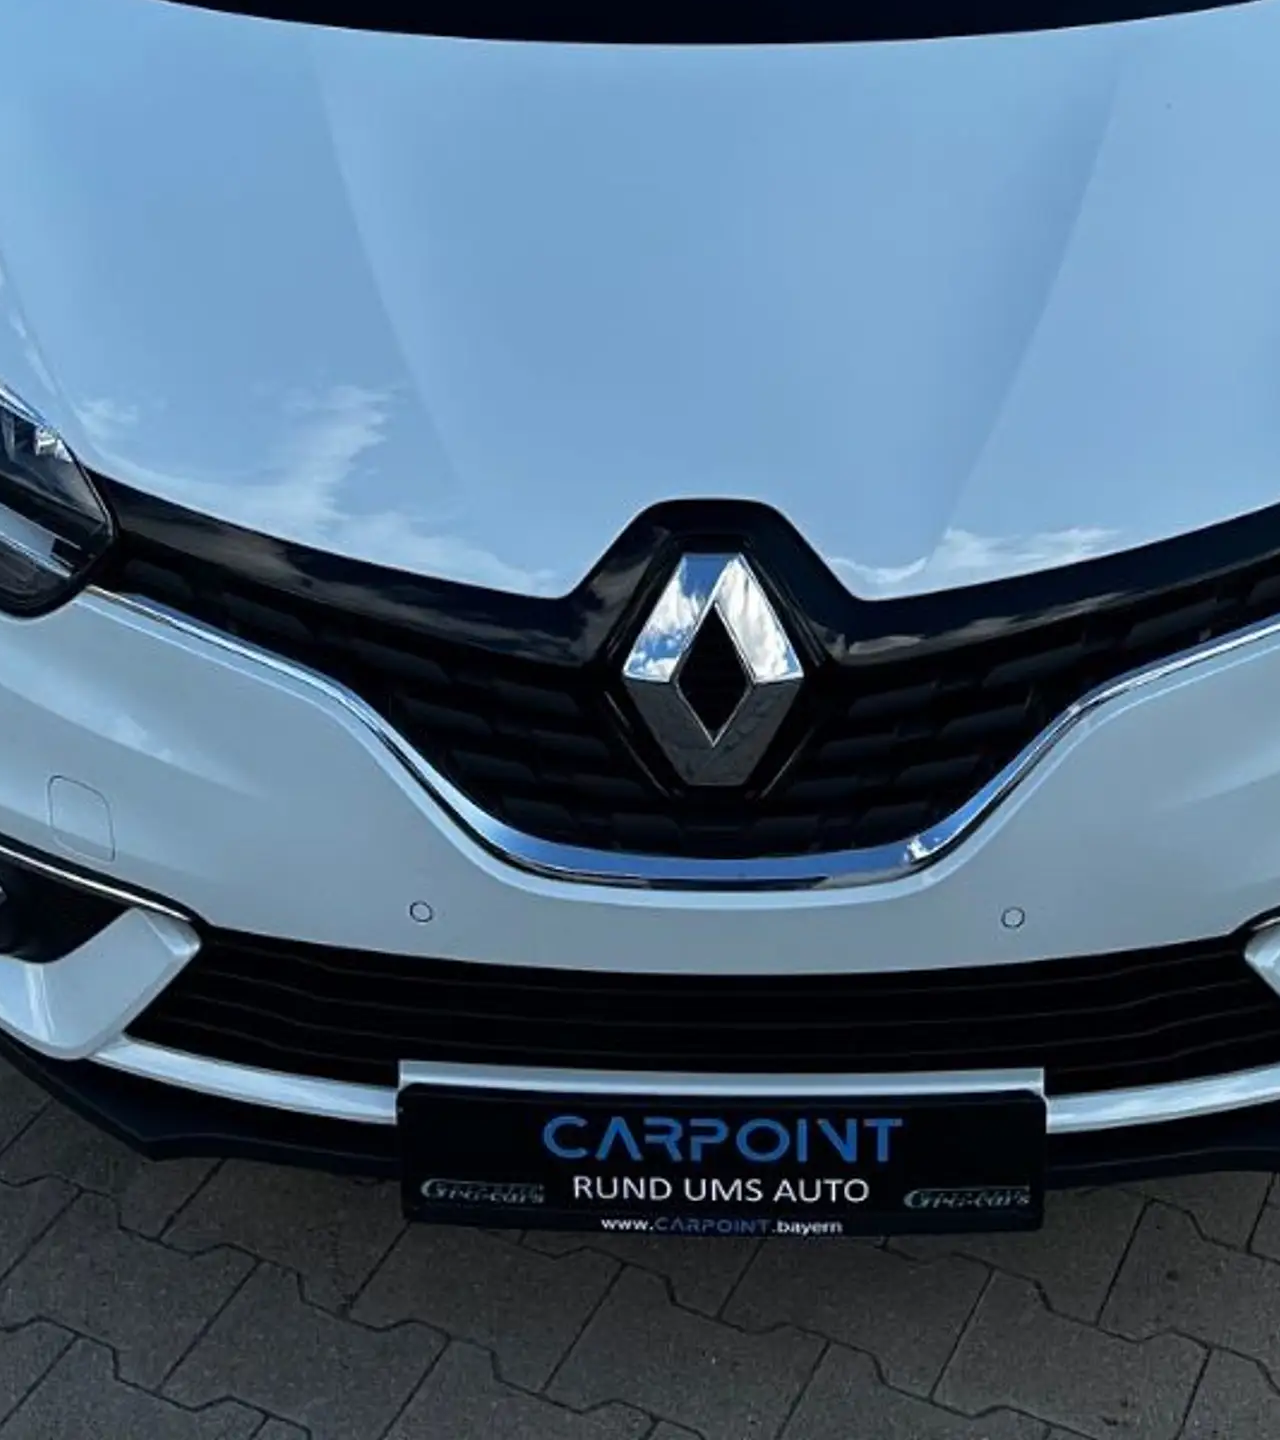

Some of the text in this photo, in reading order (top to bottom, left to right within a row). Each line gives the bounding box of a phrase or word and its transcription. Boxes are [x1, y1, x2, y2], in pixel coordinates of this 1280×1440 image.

[541, 1114, 904, 1164] CARPOINT
[572, 1174, 673, 1202] RUND
[683, 1177, 764, 1203] UMS
[772, 1177, 870, 1203] AUTO
